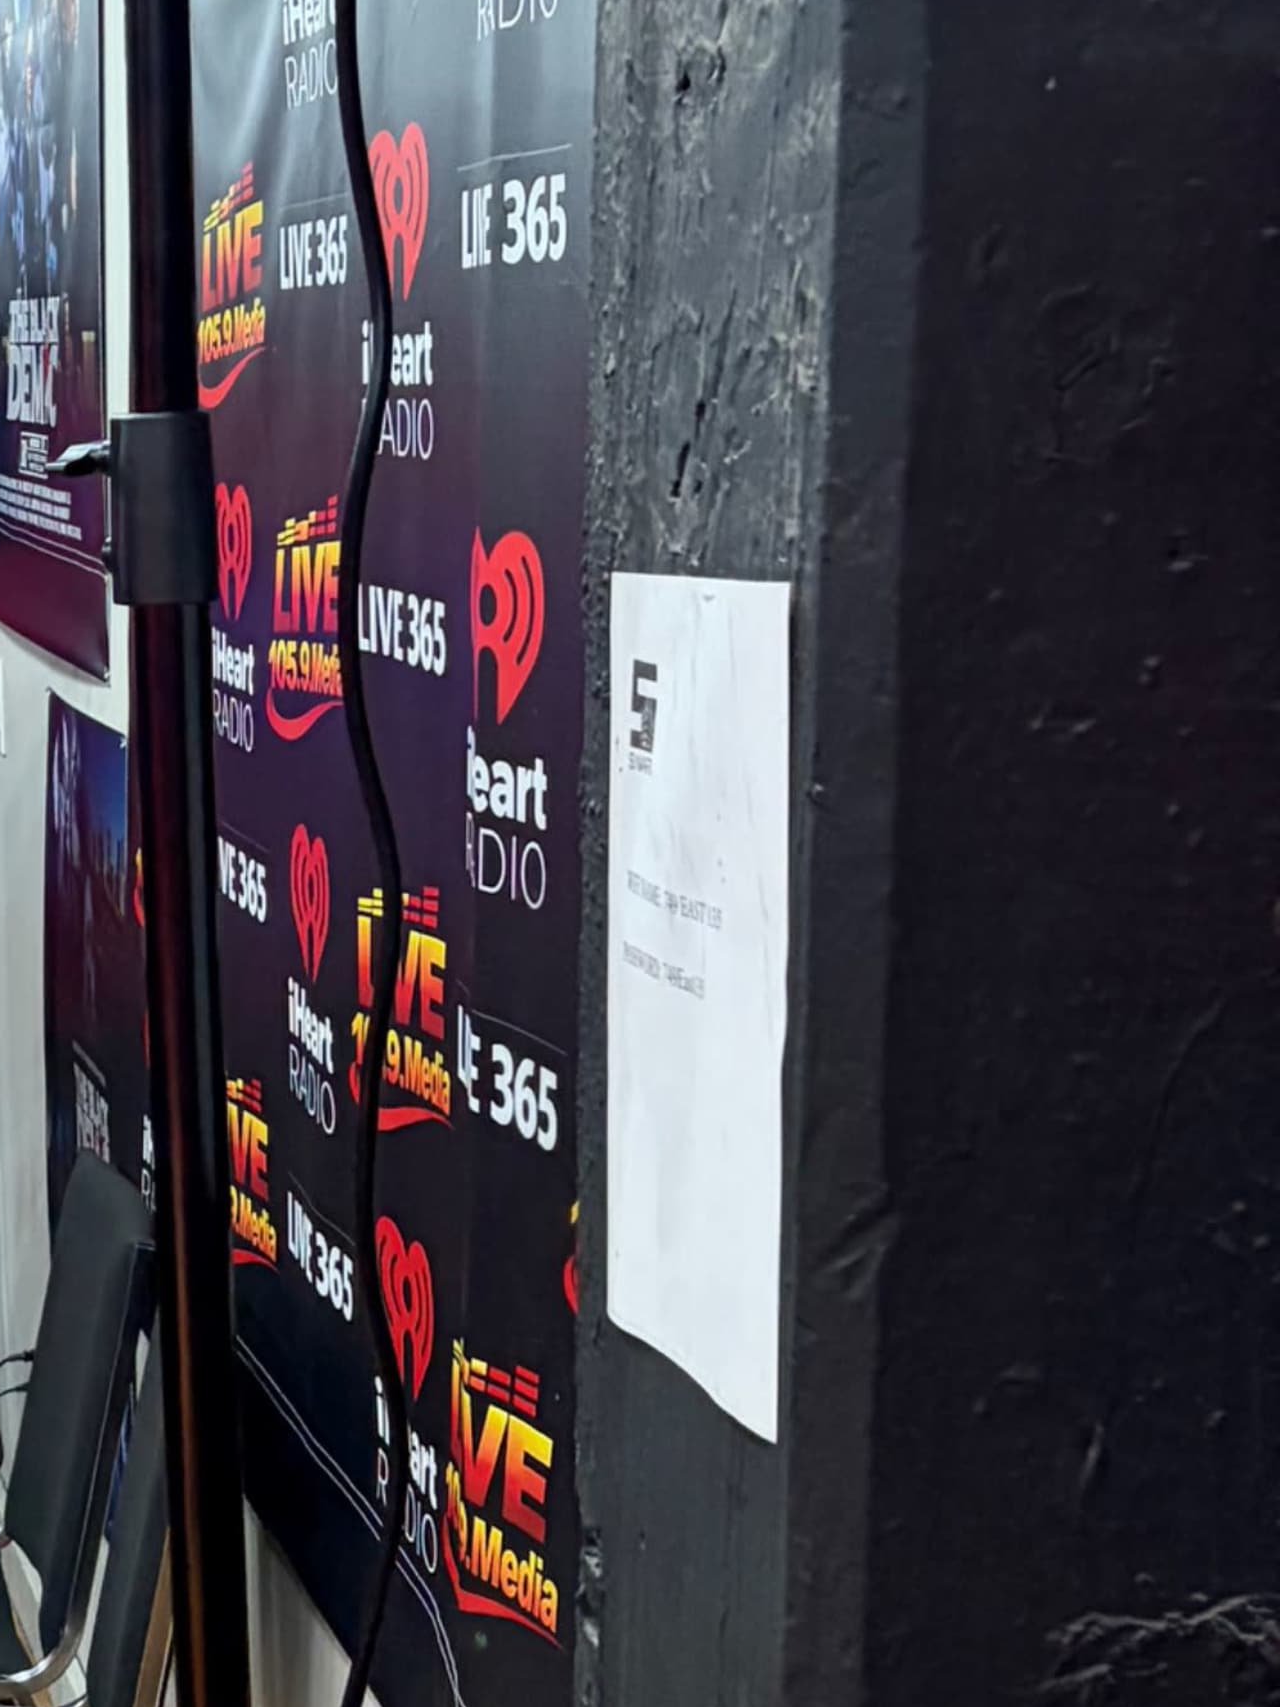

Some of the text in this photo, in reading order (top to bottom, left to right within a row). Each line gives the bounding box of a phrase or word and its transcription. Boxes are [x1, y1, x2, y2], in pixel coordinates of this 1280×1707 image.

[201, 200, 264, 312] LIVE
[279, 214, 348, 291] LIVE 365
[500, 173, 568, 265] 365
[361, 320, 433, 386] ieart
[376, 398, 434, 461] ADIO
[272, 540, 341, 635] LIVE
[357, 583, 447, 677] LIVE 365
[211, 627, 255, 696] iHeart
[213, 688, 255, 754] RADIO
[467, 725, 548, 831] ieart
[218, 836, 268, 924] VE 365
[356, 914, 447, 1041] LVE
[490, 1043, 558, 1152] 365
[228, 1101, 269, 1201] VE
[314, 1226, 354, 1323] 365
[450, 1356, 554, 1545] LVE
[374, 1447, 439, 1576] RDIO
